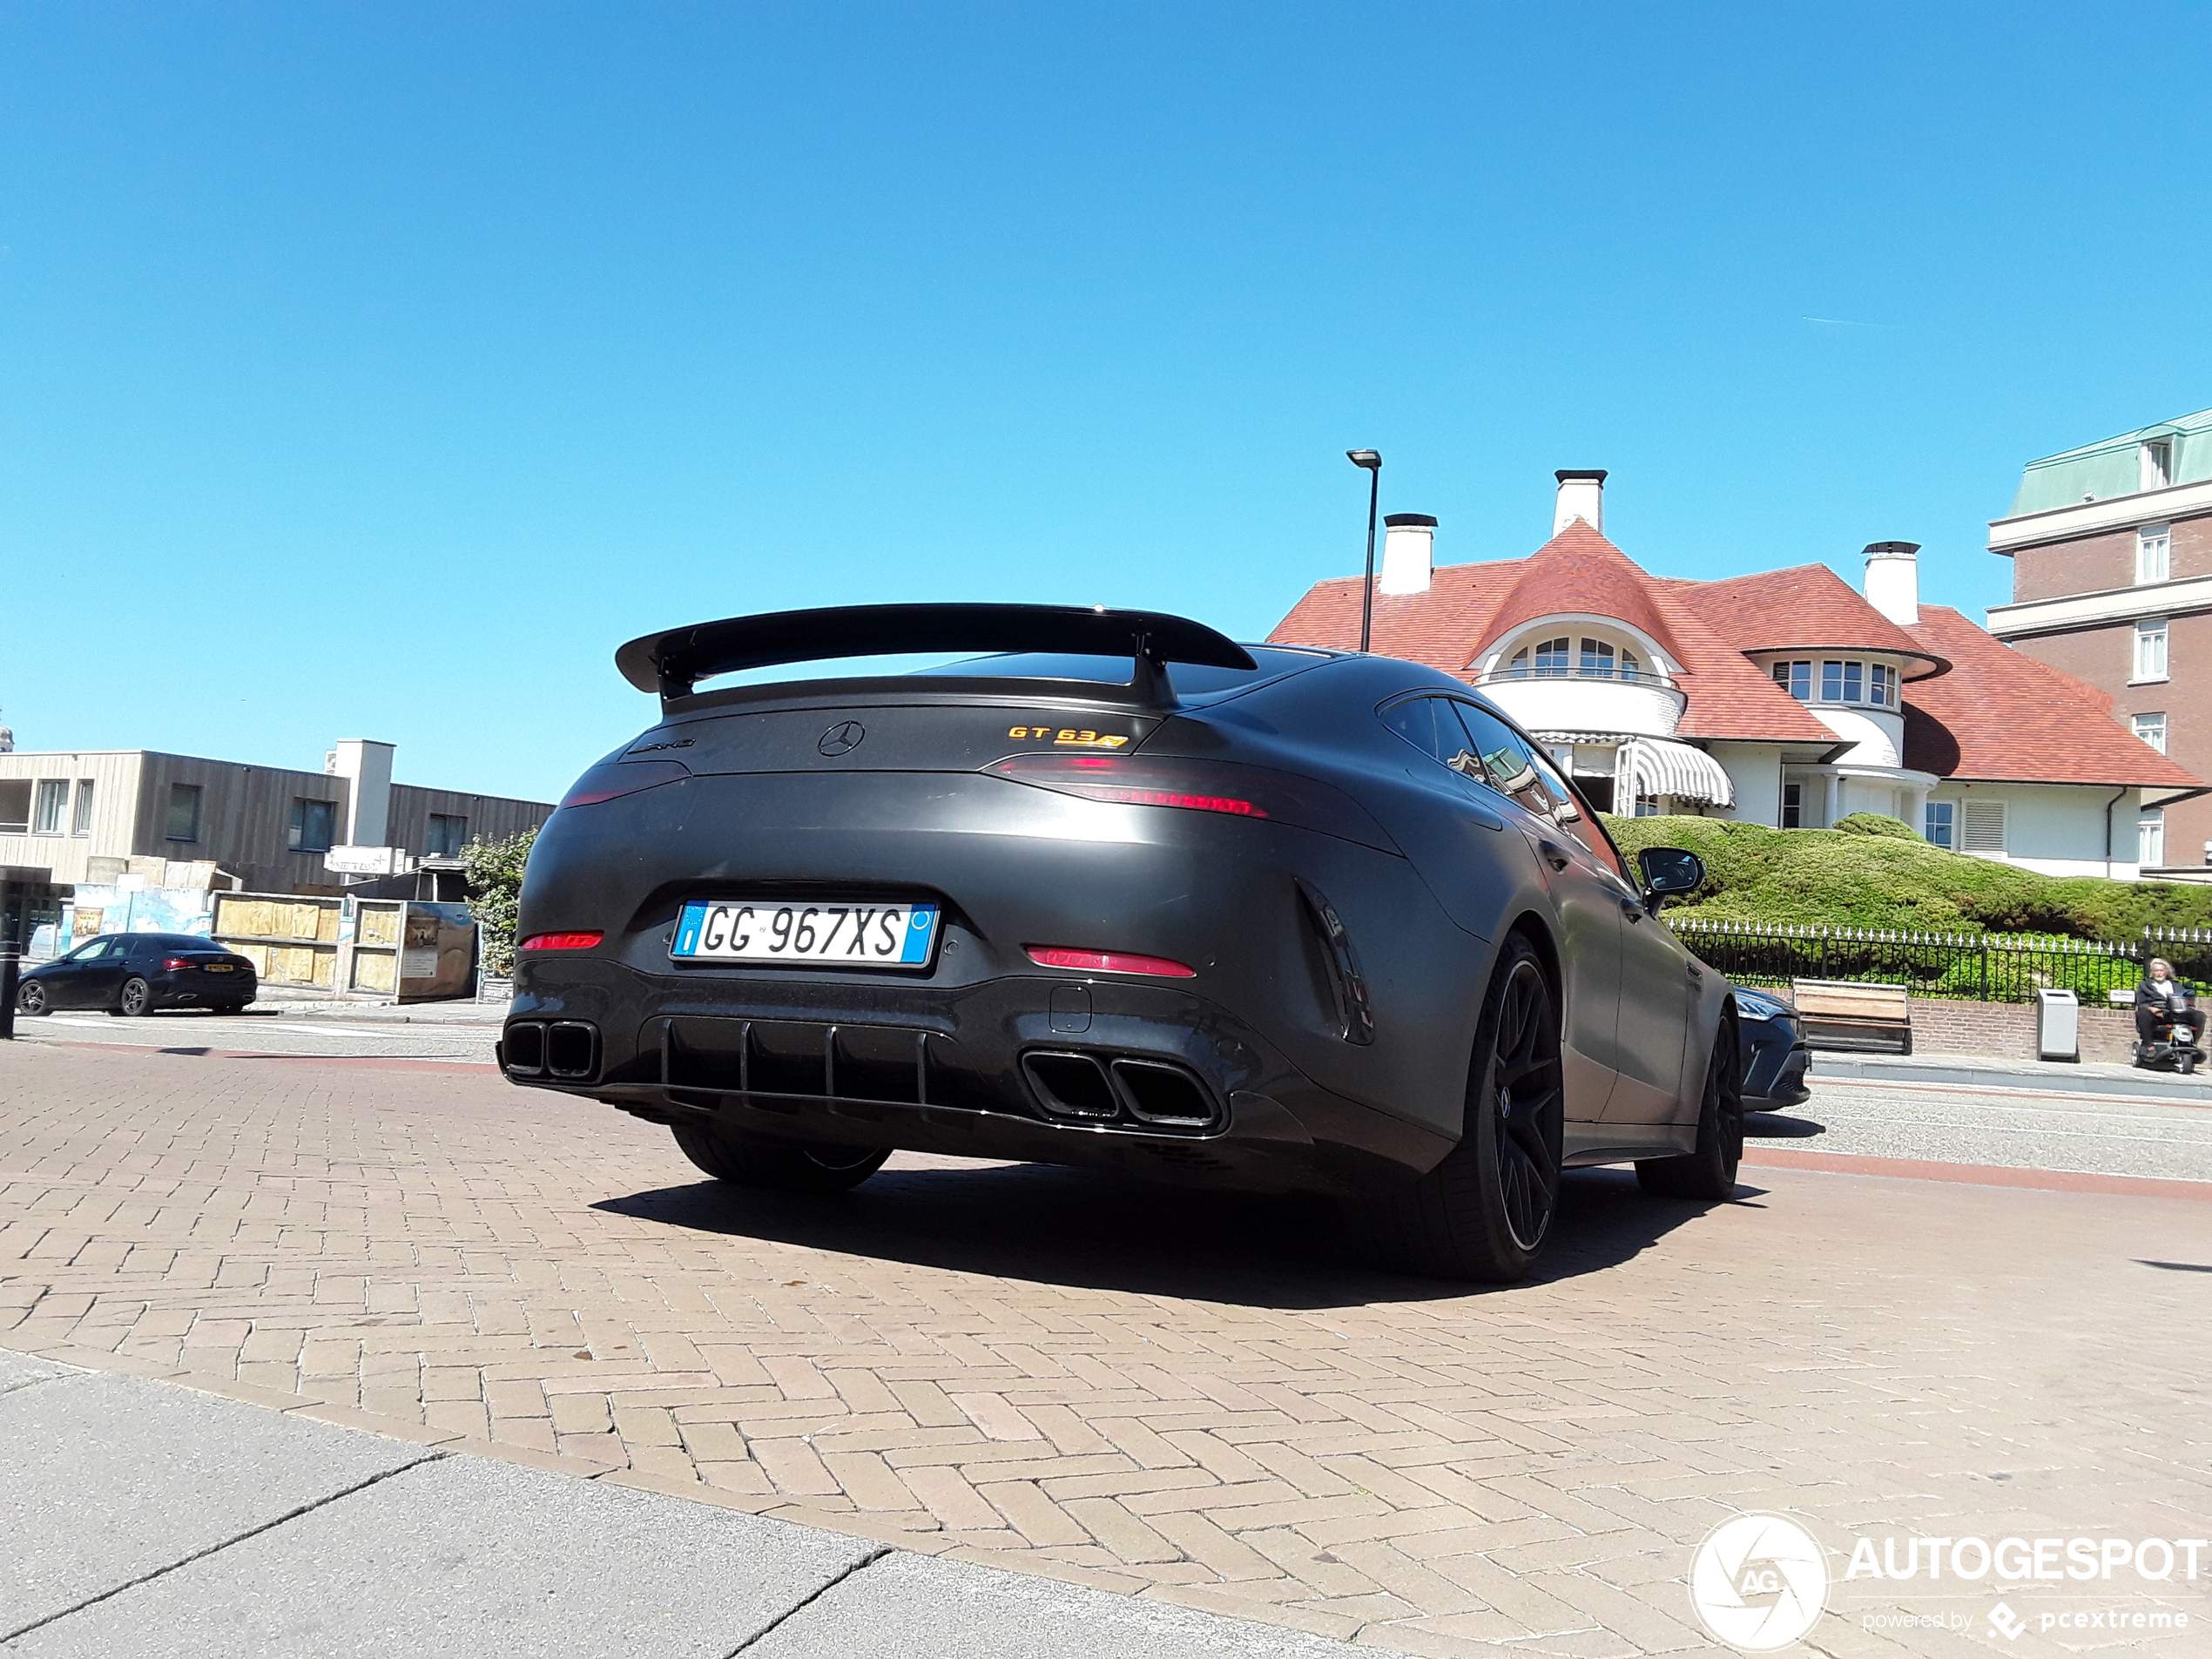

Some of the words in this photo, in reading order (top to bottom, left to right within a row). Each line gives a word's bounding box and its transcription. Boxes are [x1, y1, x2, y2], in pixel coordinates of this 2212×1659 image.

[1008, 726, 1051, 738] GT
[1056, 729, 1097, 740] 63
[704, 907, 756, 951] GG
[768, 907, 902, 955] 967XS
